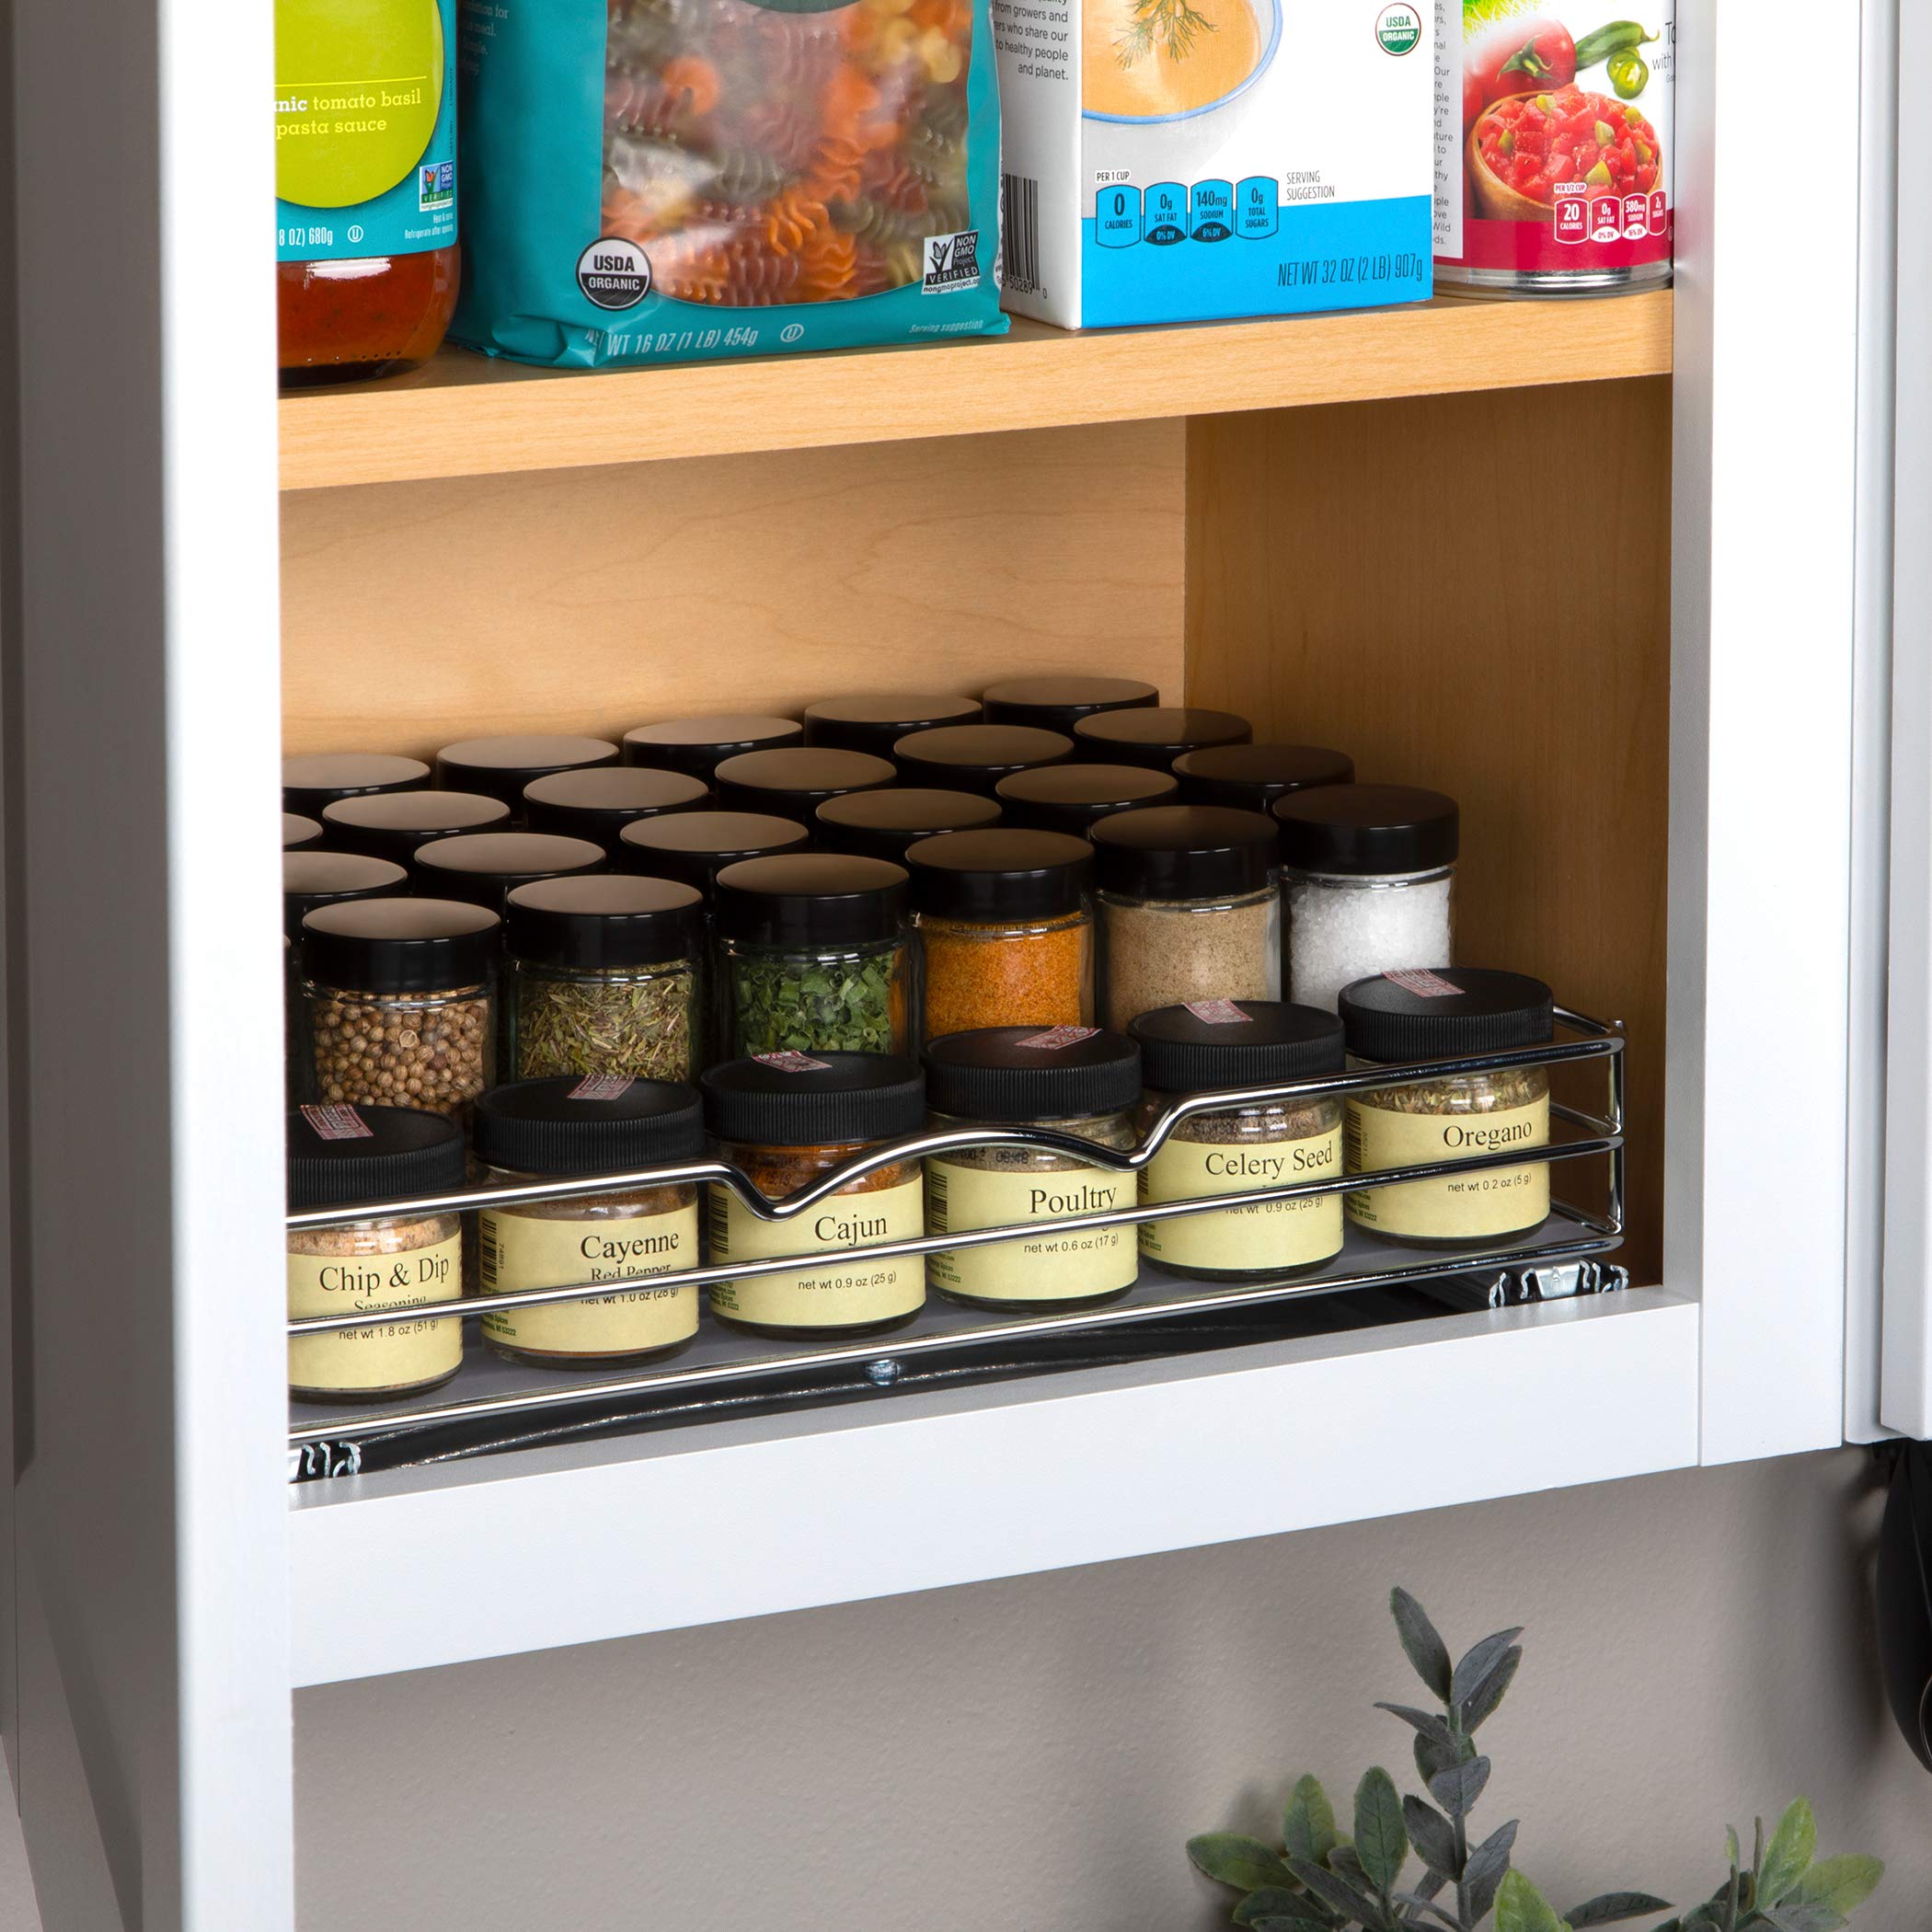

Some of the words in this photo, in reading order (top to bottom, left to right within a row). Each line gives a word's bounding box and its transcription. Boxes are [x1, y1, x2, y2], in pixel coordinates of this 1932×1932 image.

[1013, 6, 1046, 20] growers
[1049, 11, 1068, 23] and
[1386, 16, 1411, 28] USDA
[1007, 22, 1024, 35] who
[1025, 25, 1049, 40] share
[1051, 31, 1068, 41] our
[1383, 30, 1415, 41] ORGANIC
[995, 38, 1004, 51] to
[1005, 40, 1032, 58] healthy
[1035, 48, 1068, 62] people
[1652, 52, 1672, 70] with
[1018, 63, 1033, 75] and
[1035, 65, 1068, 80] planet.
[313, 94, 376, 110] tomato
[381, 88, 421, 107] basil
[276, 121, 329, 140] pasta
[335, 120, 387, 132] sauce
[1097, 172, 1110, 181] PER
[1116, 171, 1130, 180] CUP
[1286, 170, 1320, 185] SERVING
[1286, 186, 1335, 201] SUGGESTION
[1576, 183, 1586, 191] CUP
[1114, 192, 1125, 216] 0
[1160, 193, 1172, 211] 0g
[1196, 190, 1227, 207] 140mg
[1251, 188, 1263, 204] 0g
[1200, 210, 1224, 220] SODIUM
[1248, 207, 1266, 216] TOTAL
[1563, 203, 1580, 221] 20
[1602, 202, 1611, 216] 0g
[1626, 201, 1645, 213] 380mg
[1105, 220, 1133, 230] CALORIES
[1155, 213, 1166, 223] SAT
[1167, 213, 1178, 222] FAT
[1245, 218, 1269, 228] SUGARS
[1560, 222, 1583, 230] CALORIES
[289, 228, 305, 247] OZ)
[309, 226, 333, 247] 680g
[1167, 230, 1176, 239] DV
[1213, 228, 1222, 237] DV
[957, 236, 977, 247] NON
[954, 245, 975, 258] GMO
[593, 255, 635, 271] USDA
[953, 256, 974, 266] Project
[929, 267, 978, 283] VERIFIED
[1278, 261, 1300, 286] NET
[1302, 261, 1319, 285] WT
[1322, 259, 1337, 283] 32
[1340, 259, 1355, 282] OZ
[1358, 256, 1369, 283] (2
[1373, 254, 1391, 282] LB)
[1395, 253, 1422, 282] 907g
[589, 277, 640, 290] ORGANIC
[909, 324, 940, 334] Serving
[940, 320, 984, 332] suggestion
[607, 334, 631, 356] WT
[635, 334, 652, 353] 16
[655, 332, 675, 351] OZ
[676, 331, 694, 351] (1
[695, 329, 721, 349] LB)
[723, 327, 759, 347] 454g
[1443, 1121, 1533, 1150] Oregano
[1205, 1152, 1284, 1179] Celery
[1293, 1141, 1333, 1172] Seed
[1448, 1183, 1464, 1191] net
[1467, 1182, 1479, 1191] wt
[1501, 1179, 1511, 1188] oz
[1513, 1175, 1522, 1186] (5
[1524, 1173, 1532, 1185] g)
[1029, 1185, 1117, 1214] Poultry
[1247, 1205, 1259, 1213] wt
[1266, 1202, 1282, 1213] 0.9
[1285, 1202, 1296, 1212] oz
[1299, 1198, 1313, 1211] (25
[1315, 1196, 1323, 1208] g)
[814, 1214, 888, 1247] Cajun
[581, 1233, 679, 1264] Cayenne
[1024, 1243, 1041, 1254] net
[1045, 1242, 1058, 1253] wt
[1062, 1240, 1078, 1252] 0.6
[1081, 1239, 1093, 1249] oz
[1095, 1235, 1110, 1249] (17
[1110, 1233, 1119, 1246] g)
[319, 1266, 380, 1296] Chip
[389, 1262, 410, 1287] &
[419, 1254, 449, 1283] Dip
[592, 1267, 621, 1282] Red
[798, 1279, 815, 1290] net
[819, 1278, 833, 1289] wt
[835, 1277, 853, 1289] 0.9
[855, 1276, 868, 1287] oz
[870, 1272, 885, 1288] (25
[887, 1270, 897, 1283] g)
[639, 1292, 650, 1301] oz
[654, 1289, 668, 1301] (28
[671, 1288, 679, 1298] g)
[339, 1330, 357, 1340] net
[361, 1328, 374, 1339] wt
[378, 1327, 395, 1338] 1.8
[398, 1326, 410, 1336] oz
[414, 1320, 427, 1334] (51
[430, 1318, 439, 1331] g)
